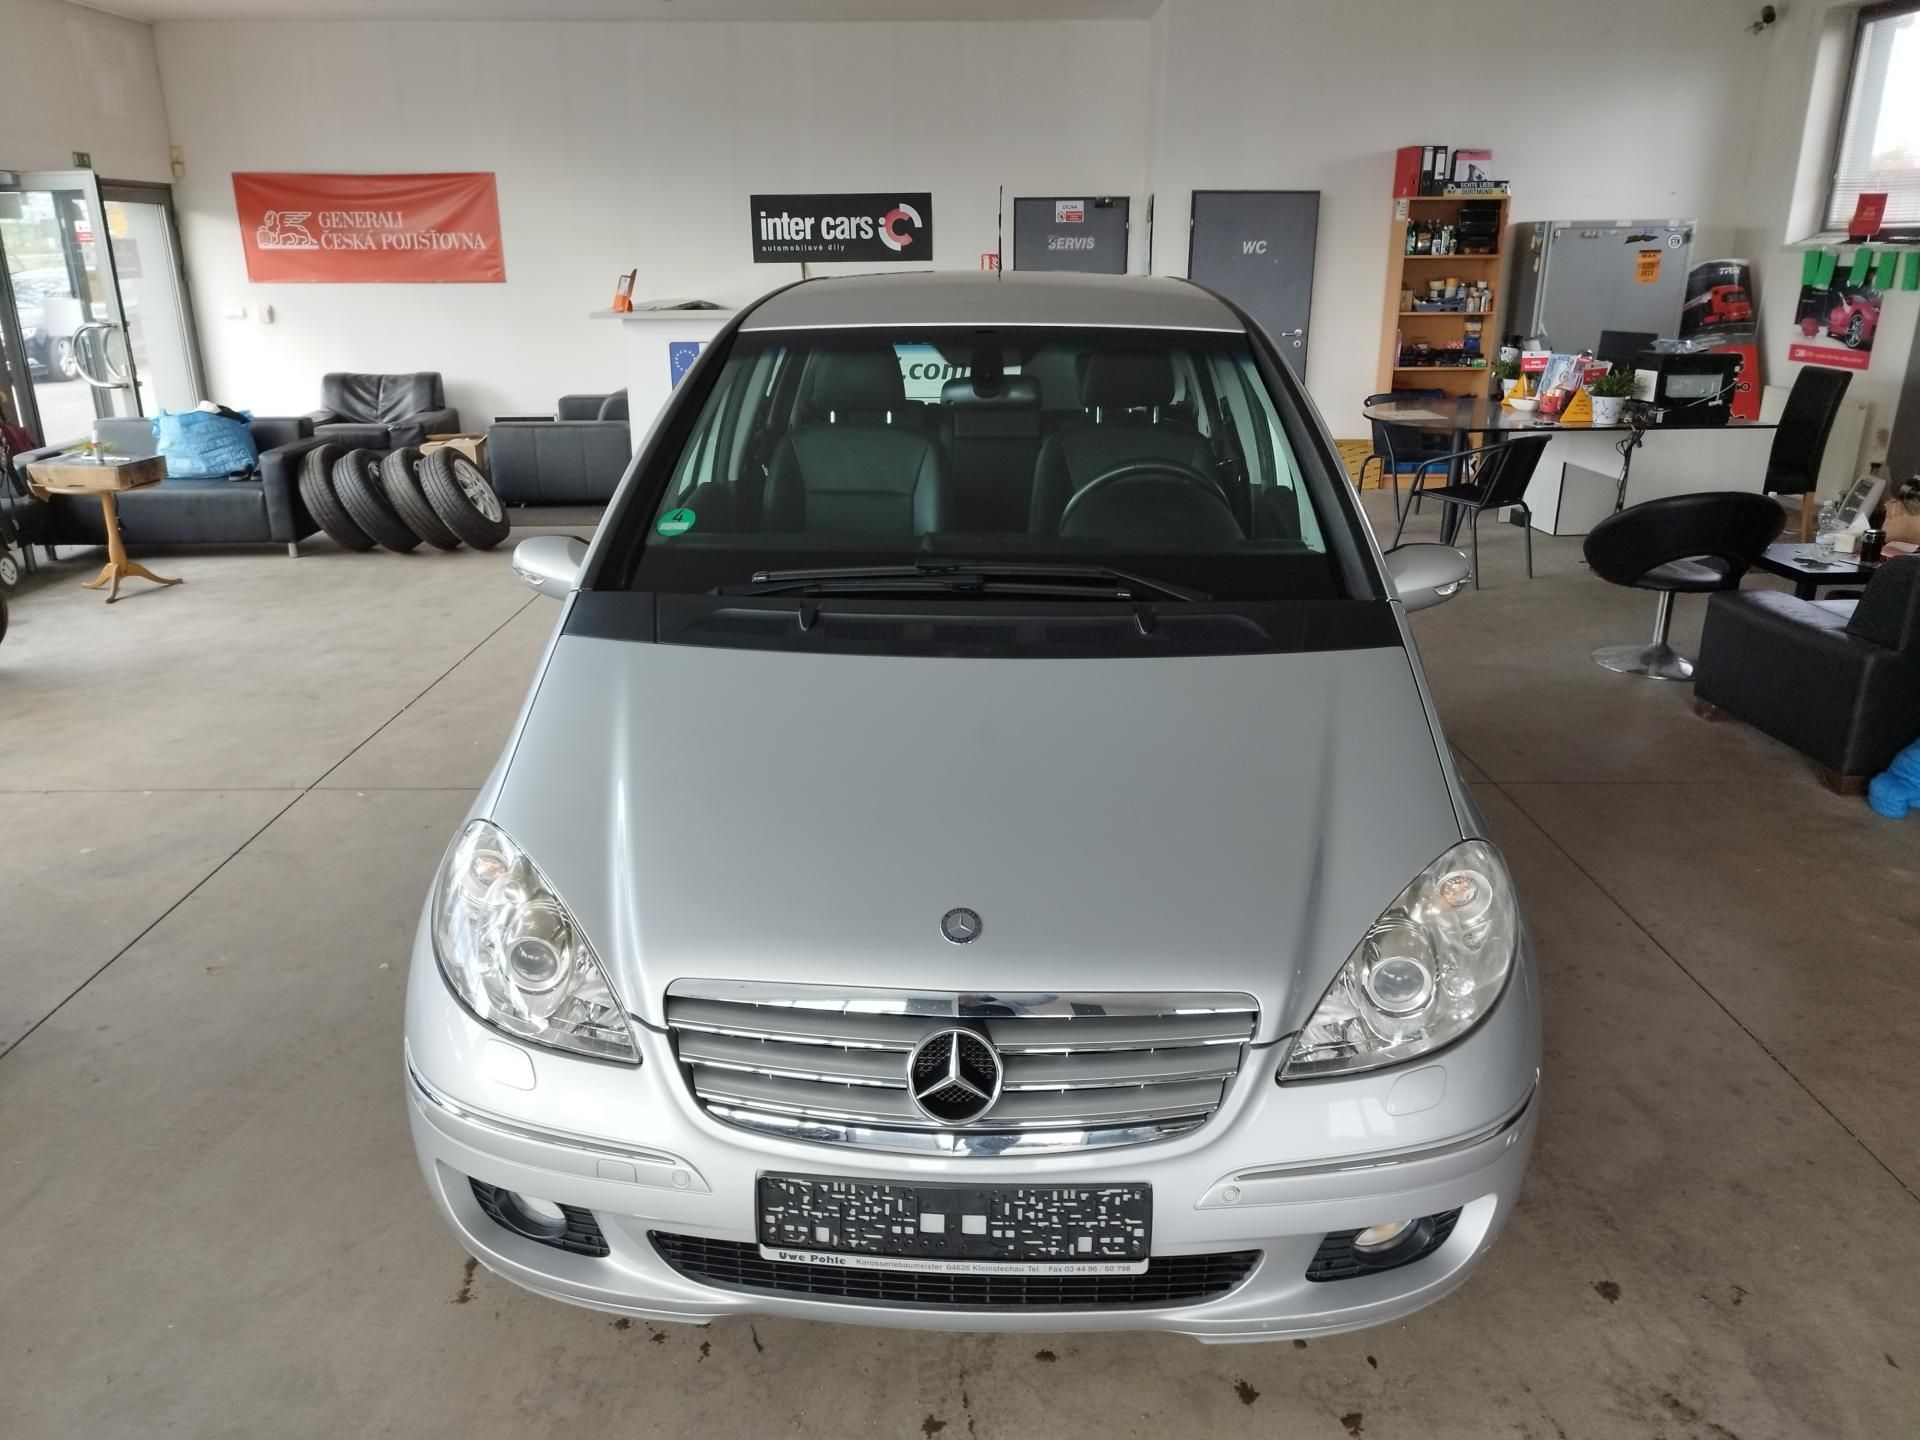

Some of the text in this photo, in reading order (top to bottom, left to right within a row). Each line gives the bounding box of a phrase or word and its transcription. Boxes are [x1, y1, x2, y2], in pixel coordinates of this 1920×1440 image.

[318, 211, 403, 229] GENERALI
[760, 211, 873, 241] inter cars
[320, 229, 487, 250] ČESKÁ POJIŠŤOVNA
[1048, 236, 1095, 250] SERVIS
[1243, 240, 1268, 255] WC
[761, 244, 823, 252] automobilové
[672, 509, 685, 522] 4
[778, 1251, 806, 1262] Uwe
[810, 1254, 846, 1265] Pohle
[856, 1258, 942, 1270] Karosseriebaumeister
